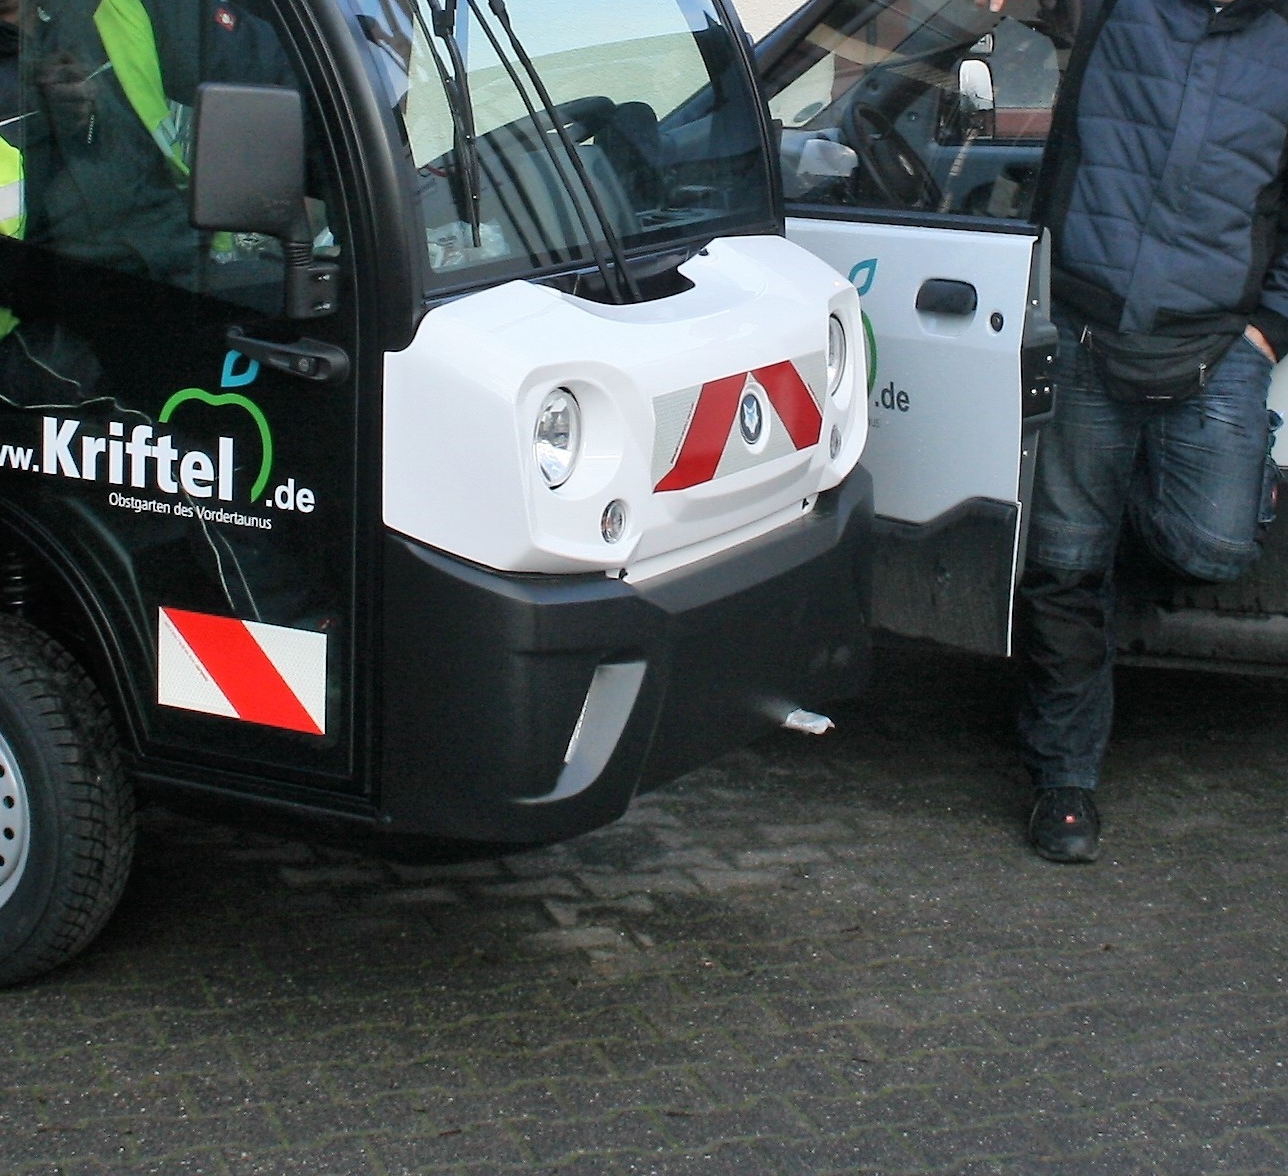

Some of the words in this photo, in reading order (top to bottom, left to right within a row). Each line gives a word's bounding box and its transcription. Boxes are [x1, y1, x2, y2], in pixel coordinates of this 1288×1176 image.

[108, 492, 171, 515] Obstgarten
[174, 501, 193, 520] des
[195, 507, 272, 530] Vordertaunus
